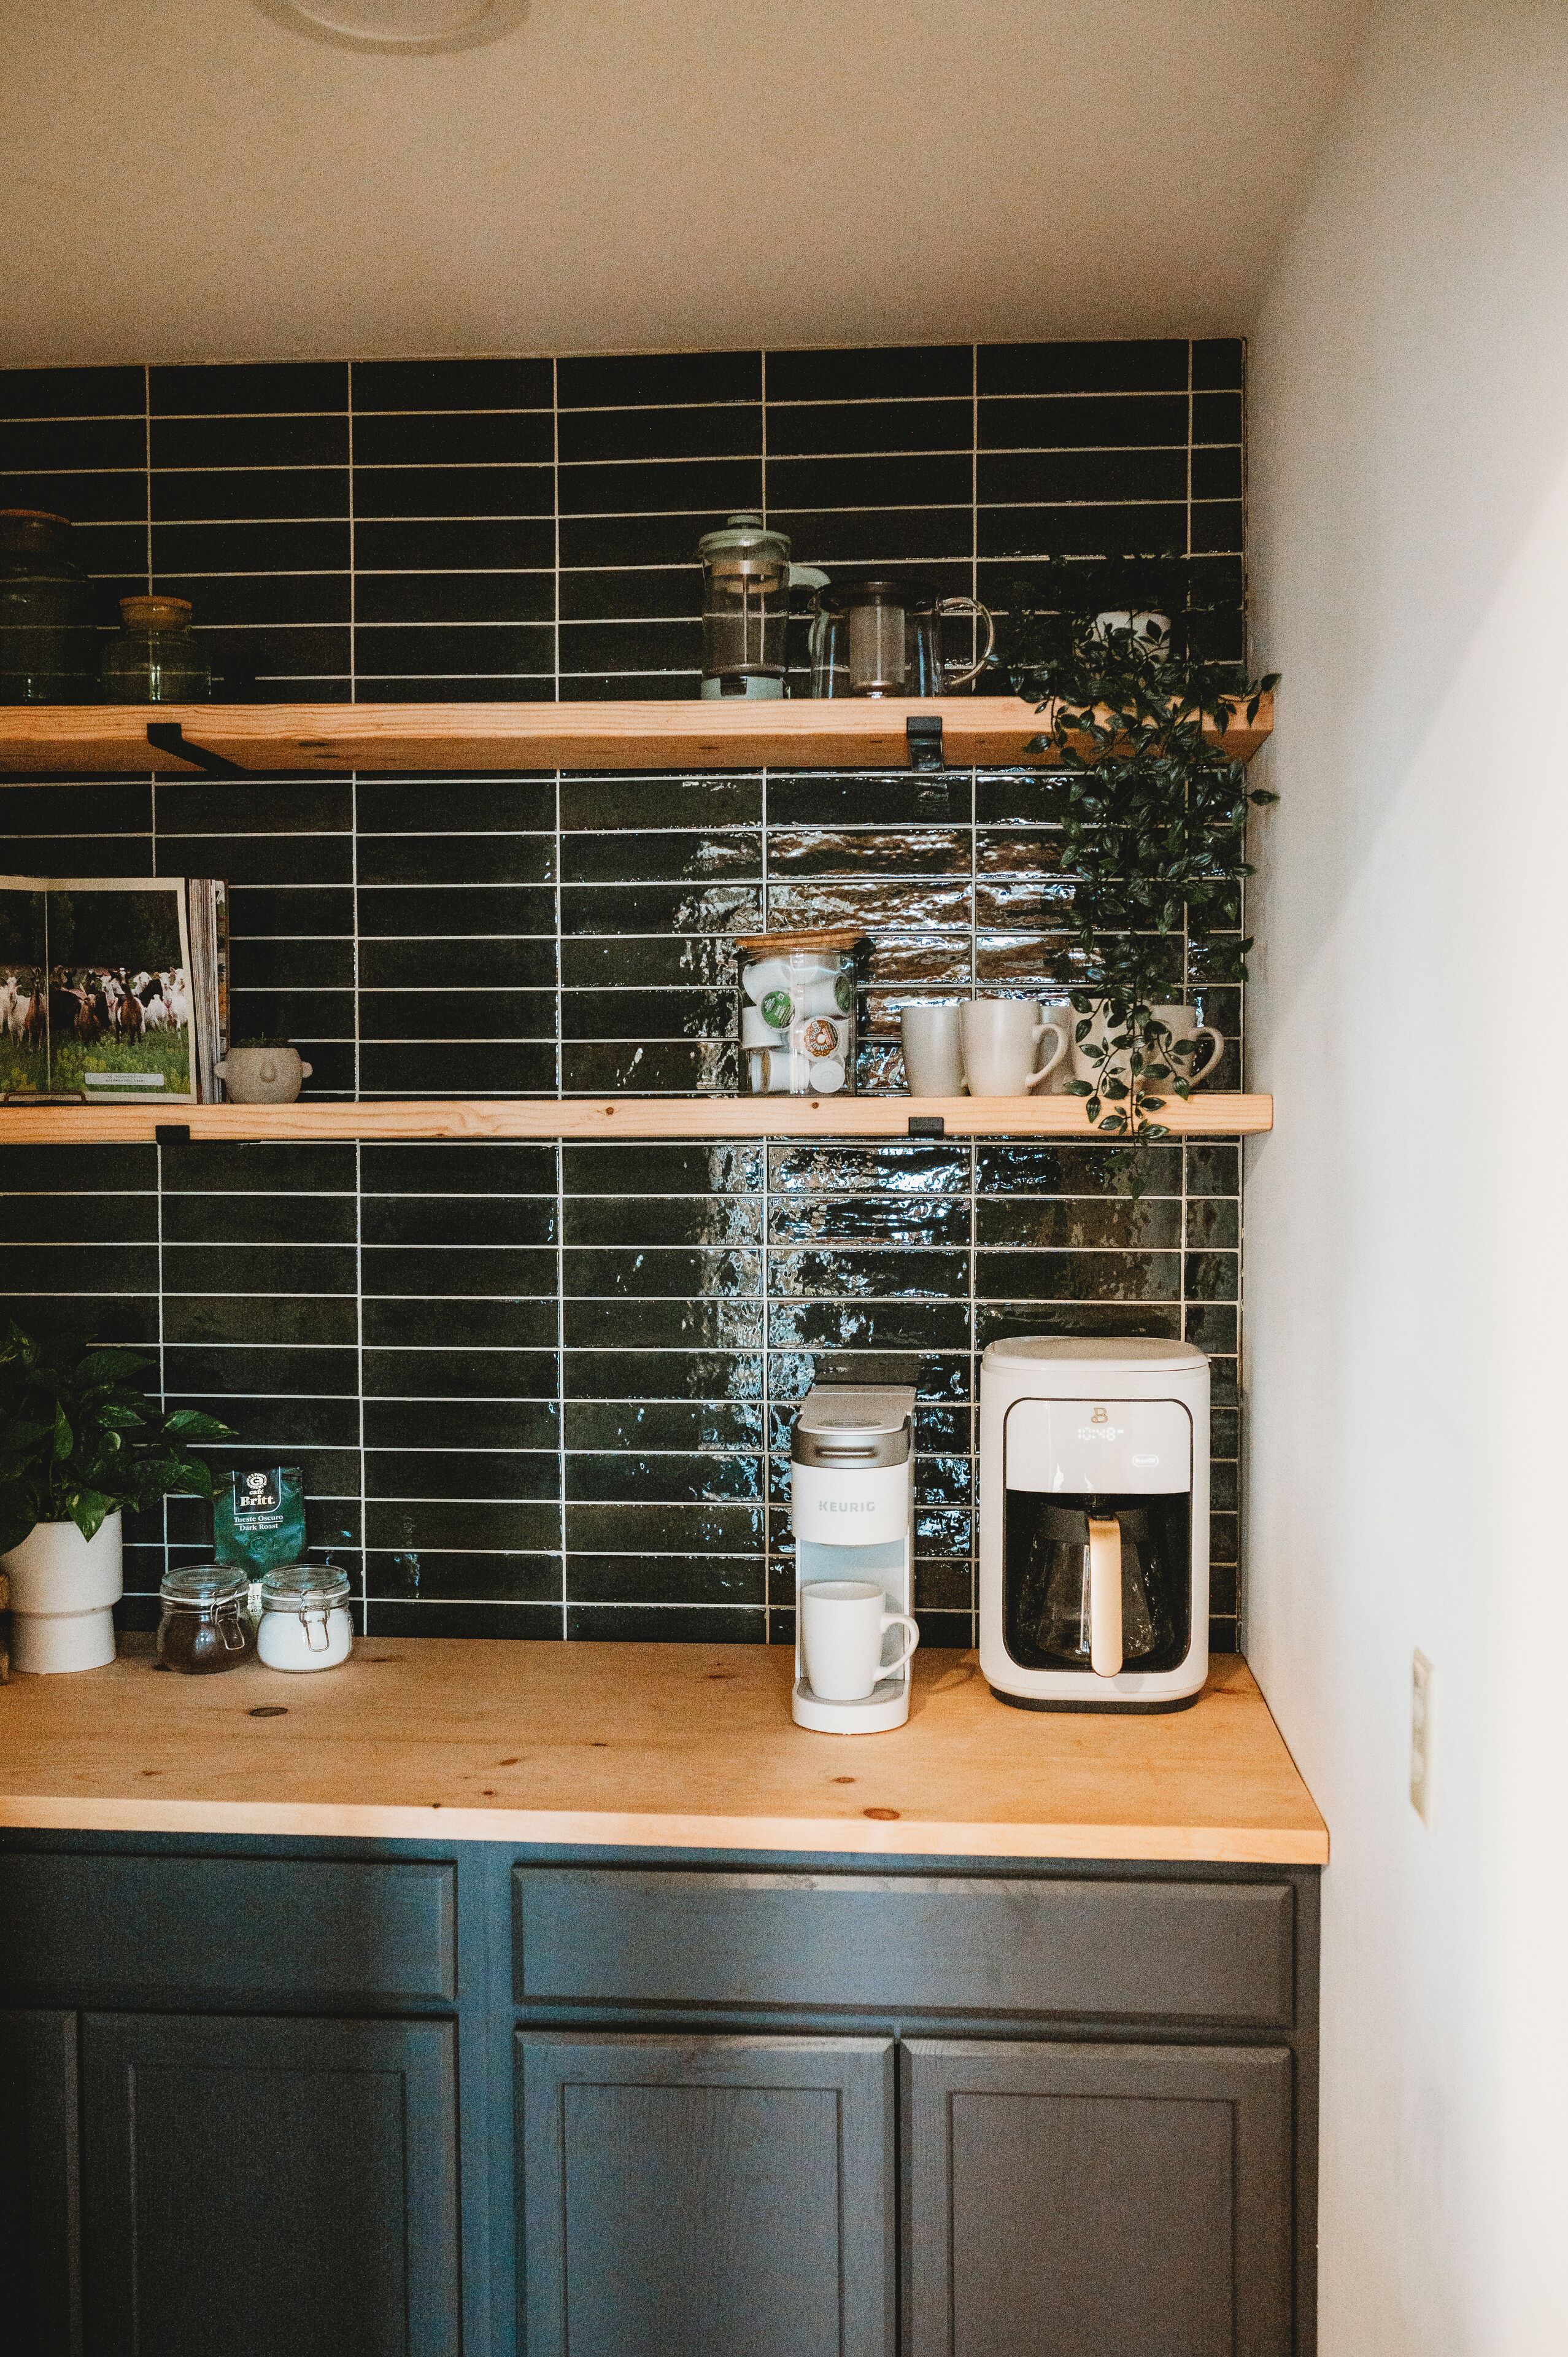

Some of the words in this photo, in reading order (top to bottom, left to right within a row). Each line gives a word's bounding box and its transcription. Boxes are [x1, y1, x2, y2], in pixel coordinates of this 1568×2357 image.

[810, 1027, 821, 1040] SHOP
[1078, 1427, 1116, 1441] 10:48
[819, 1501, 875, 1512] KEURIG
